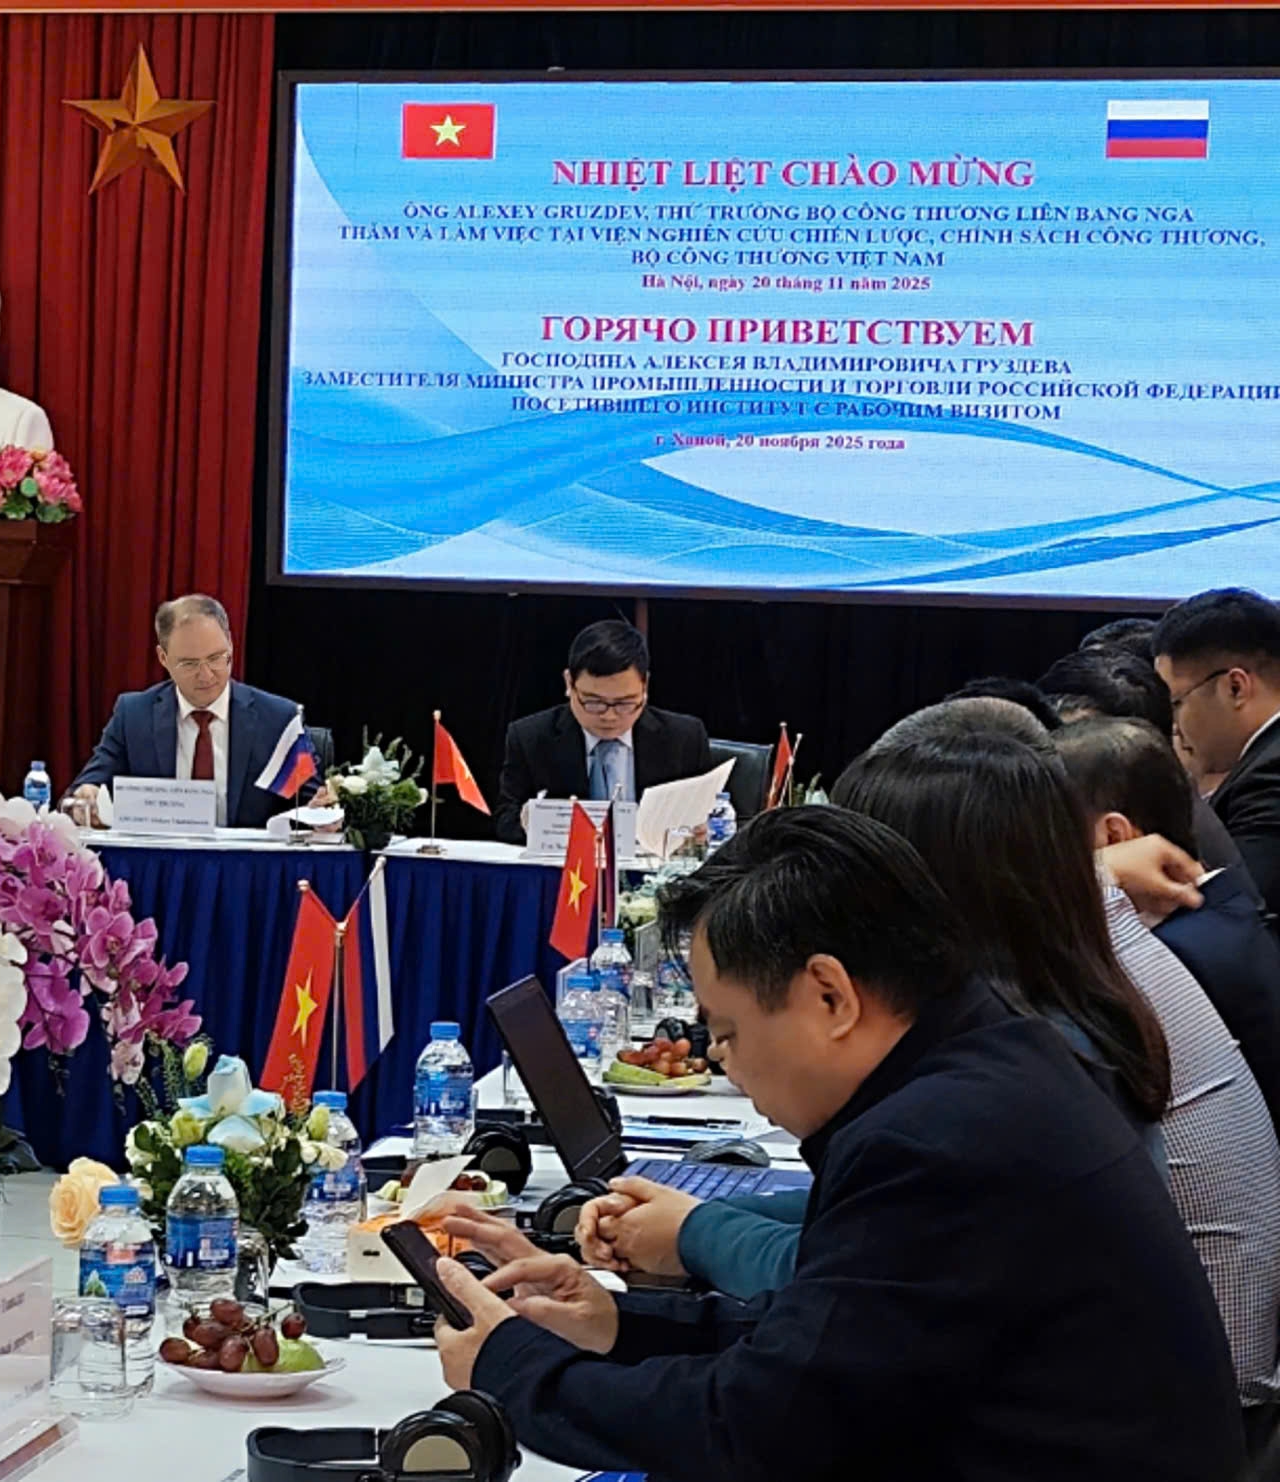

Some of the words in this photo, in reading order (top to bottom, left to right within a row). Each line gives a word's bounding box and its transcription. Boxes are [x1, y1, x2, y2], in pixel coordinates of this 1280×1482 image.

[553, 156, 672, 192] NHIỆT
[684, 157, 773, 192] LIỆT
[782, 153, 898, 187] CHÀO
[909, 154, 1034, 187] MỪNG
[404, 202, 448, 219] ÔNG
[453, 204, 537, 219] ALEXEY
[544, 204, 649, 221] GRUZDEV,
[807, 204, 836, 224] BỘ
[842, 202, 906, 221] CÔNG
[913, 203, 1010, 221] THƯƠNG
[1016, 202, 1069, 222] LIÊN
[1076, 206, 1138, 222] BANG
[1145, 206, 1194, 223] NGA
[406, 223, 433, 240] VÀ
[439, 222, 486, 241] LÀM
[493, 225, 544, 245] VIỆC
[550, 226, 584, 244] TẠI
[591, 225, 641, 246] VIỆN
[648, 225, 730, 242] NGHIÊN
[737, 224, 783, 243] CỨU
[866, 226, 935, 247] LƯỢC,
[941, 224, 1013, 244] CHÍNH
[1020, 226, 1080, 245] SÁCH
[1086, 226, 1152, 245] CÔNG
[1160, 228, 1266, 248] THƯƠNG,
[632, 250, 660, 268] BỘ
[667, 247, 729, 265] CÔNG
[735, 249, 831, 267] THƯƠNG
[836, 250, 888, 269] VIỆT
[894, 250, 945, 267] NAM
[642, 274, 666, 289] Hà
[671, 274, 703, 292] Nội,
[708, 275, 745, 292] ngày
[752, 275, 771, 289] 20
[776, 276, 823, 292] tháng
[829, 276, 844, 290] 11
[850, 276, 887, 291] năm
[891, 276, 931, 290] 2025
[541, 316, 697, 343] ГОРЯЧО
[708, 318, 1034, 347] ПРИВЕТСТВУЕМ
[502, 352, 637, 370] ГОСПОДИНА
[644, 354, 746, 371] АЛЕКСЕЯ
[752, 355, 957, 374] ВЛАДИМИРОВИЧА
[961, 358, 1072, 375] ГРУЗДЕВА
[303, 371, 460, 387] ЗАМЕСТИТЕЛЯ
[466, 374, 585, 389] МИНИСТРА
[591, 376, 828, 393] ПРОМЫШЛЕННОСТИ
[830, 379, 845, 393] И
[852, 379, 971, 395] ТОРГОВЛИ
[978, 380, 1140, 398] РОССИЙСКОЙ
[512, 396, 681, 413] ПОСЕТИВШЕГО
[687, 400, 807, 416] ИНСТИТУТ
[815, 401, 829, 416] С
[835, 402, 943, 418] РАБОЧИМ
[951, 404, 1062, 420] ВИЗИТОМ
[672, 433, 730, 449] Ханой,
[736, 433, 754, 447] 20
[760, 434, 820, 451] ноября
[825, 433, 863, 449] 2025
[869, 437, 905, 451] года
